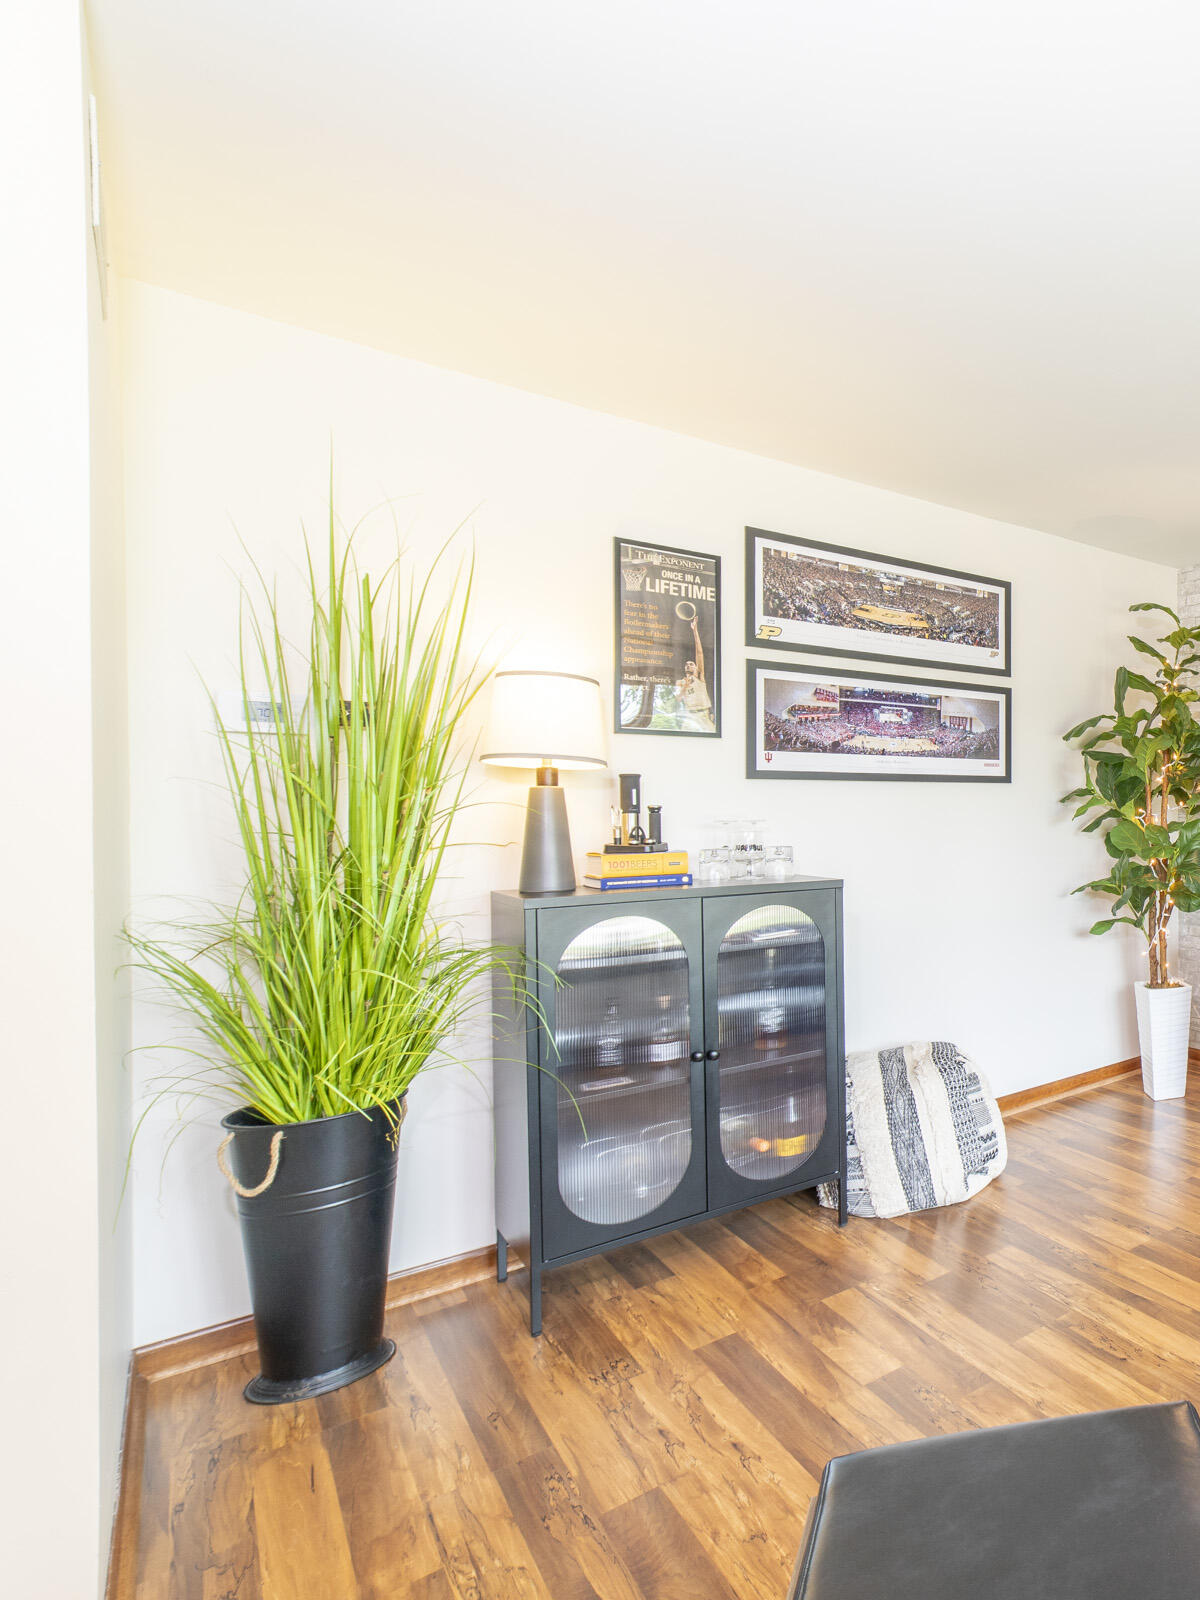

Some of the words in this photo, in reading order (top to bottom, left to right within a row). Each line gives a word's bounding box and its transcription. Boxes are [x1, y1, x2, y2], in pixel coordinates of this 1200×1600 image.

[660, 554, 704, 570] EXPONENT
[662, 570, 683, 580] ONCE
[685, 574, 693, 582] IN
[646, 577, 716, 601] LIFETIME
